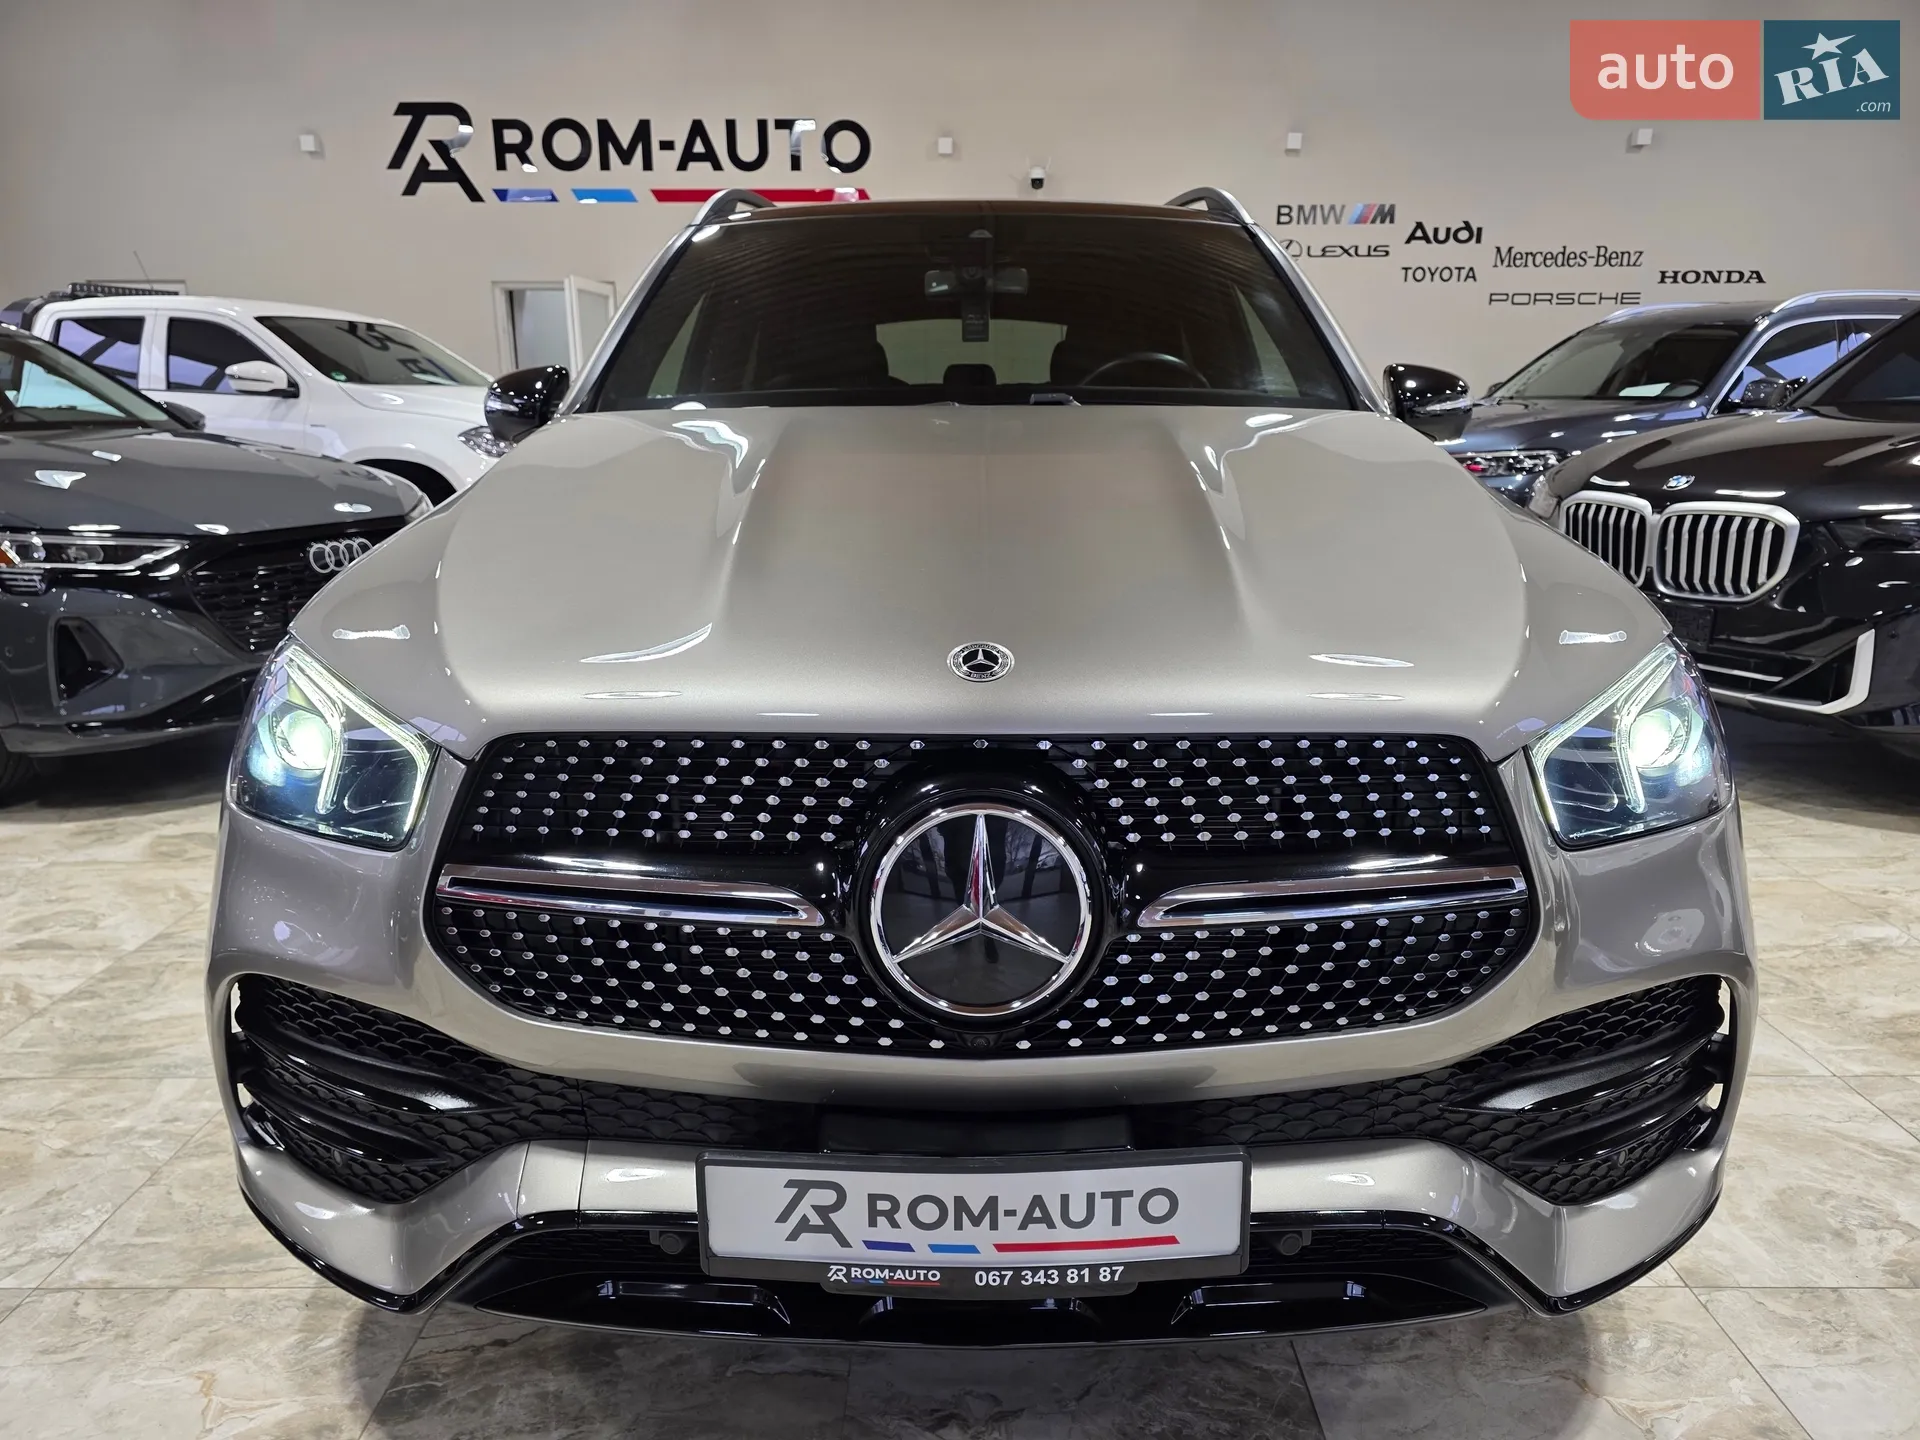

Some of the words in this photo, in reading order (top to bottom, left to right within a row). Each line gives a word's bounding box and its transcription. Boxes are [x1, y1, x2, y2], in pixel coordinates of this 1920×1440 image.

[491, 117, 872, 174] ROM-AUTO
[1276, 204, 1346, 226] BMW
[1404, 220, 1483, 245] Audi
[1307, 244, 1390, 258] LEXUS
[1492, 246, 1644, 268] Mercedes-Benz
[1401, 266, 1477, 283] TOYOTA
[1657, 270, 1767, 285] HONDA
[1488, 292, 1643, 306] PORSCHE
[866, 1187, 1180, 1232] ROM-AUTO
[850, 1267, 941, 1282] ROM-AUTO
[974, 1270, 1014, 1286] 067
[1020, 1269, 1060, 1285] 343
[1066, 1267, 1090, 1284] 81
[1098, 1265, 1125, 1282] 87
